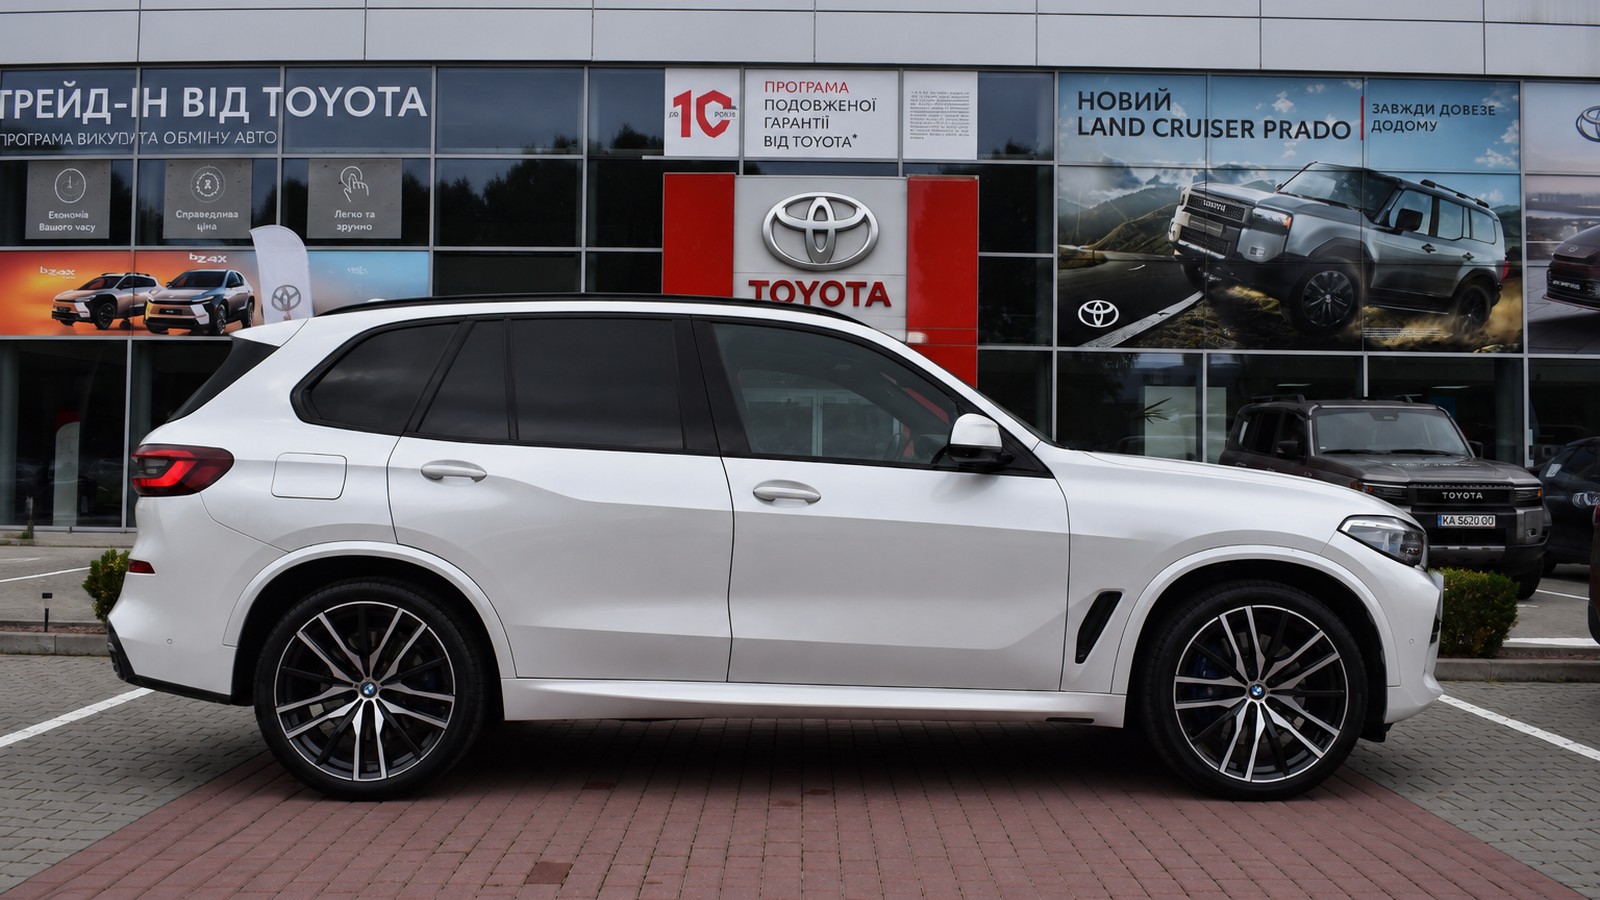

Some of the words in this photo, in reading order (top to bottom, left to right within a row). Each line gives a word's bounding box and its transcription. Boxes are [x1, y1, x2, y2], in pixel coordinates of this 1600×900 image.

[764, 81, 849, 94] ПРОГРАМА
[182, 87, 250, 124] ВІД
[262, 86, 428, 118] TOYOTA
[764, 98, 877, 113] ПОДОВЖЕНОЇ
[1078, 87, 1171, 111] НОВИЙ
[1372, 103, 1435, 117] ЗАВЖДИ
[1439, 104, 1496, 117] ДОВЕЗЕ
[764, 115, 830, 129] ГАРАНТІЇ
[1078, 116, 1146, 137] LAND
[1152, 117, 1255, 139] CRUISER
[1263, 119, 1351, 140] PRADO
[1371, 119, 1438, 133] ДОДОМУ
[139, 131, 158, 145] ТА
[163, 131, 231, 145] ОБМІНУ
[234, 130, 277, 145] АВТО
[764, 135, 789, 150] ВІД
[334, 210, 363, 218] Легко
[39, 223, 73, 231] Вашого
[748, 280, 892, 307] TOYOTA
[1443, 516, 1455, 525] KA
